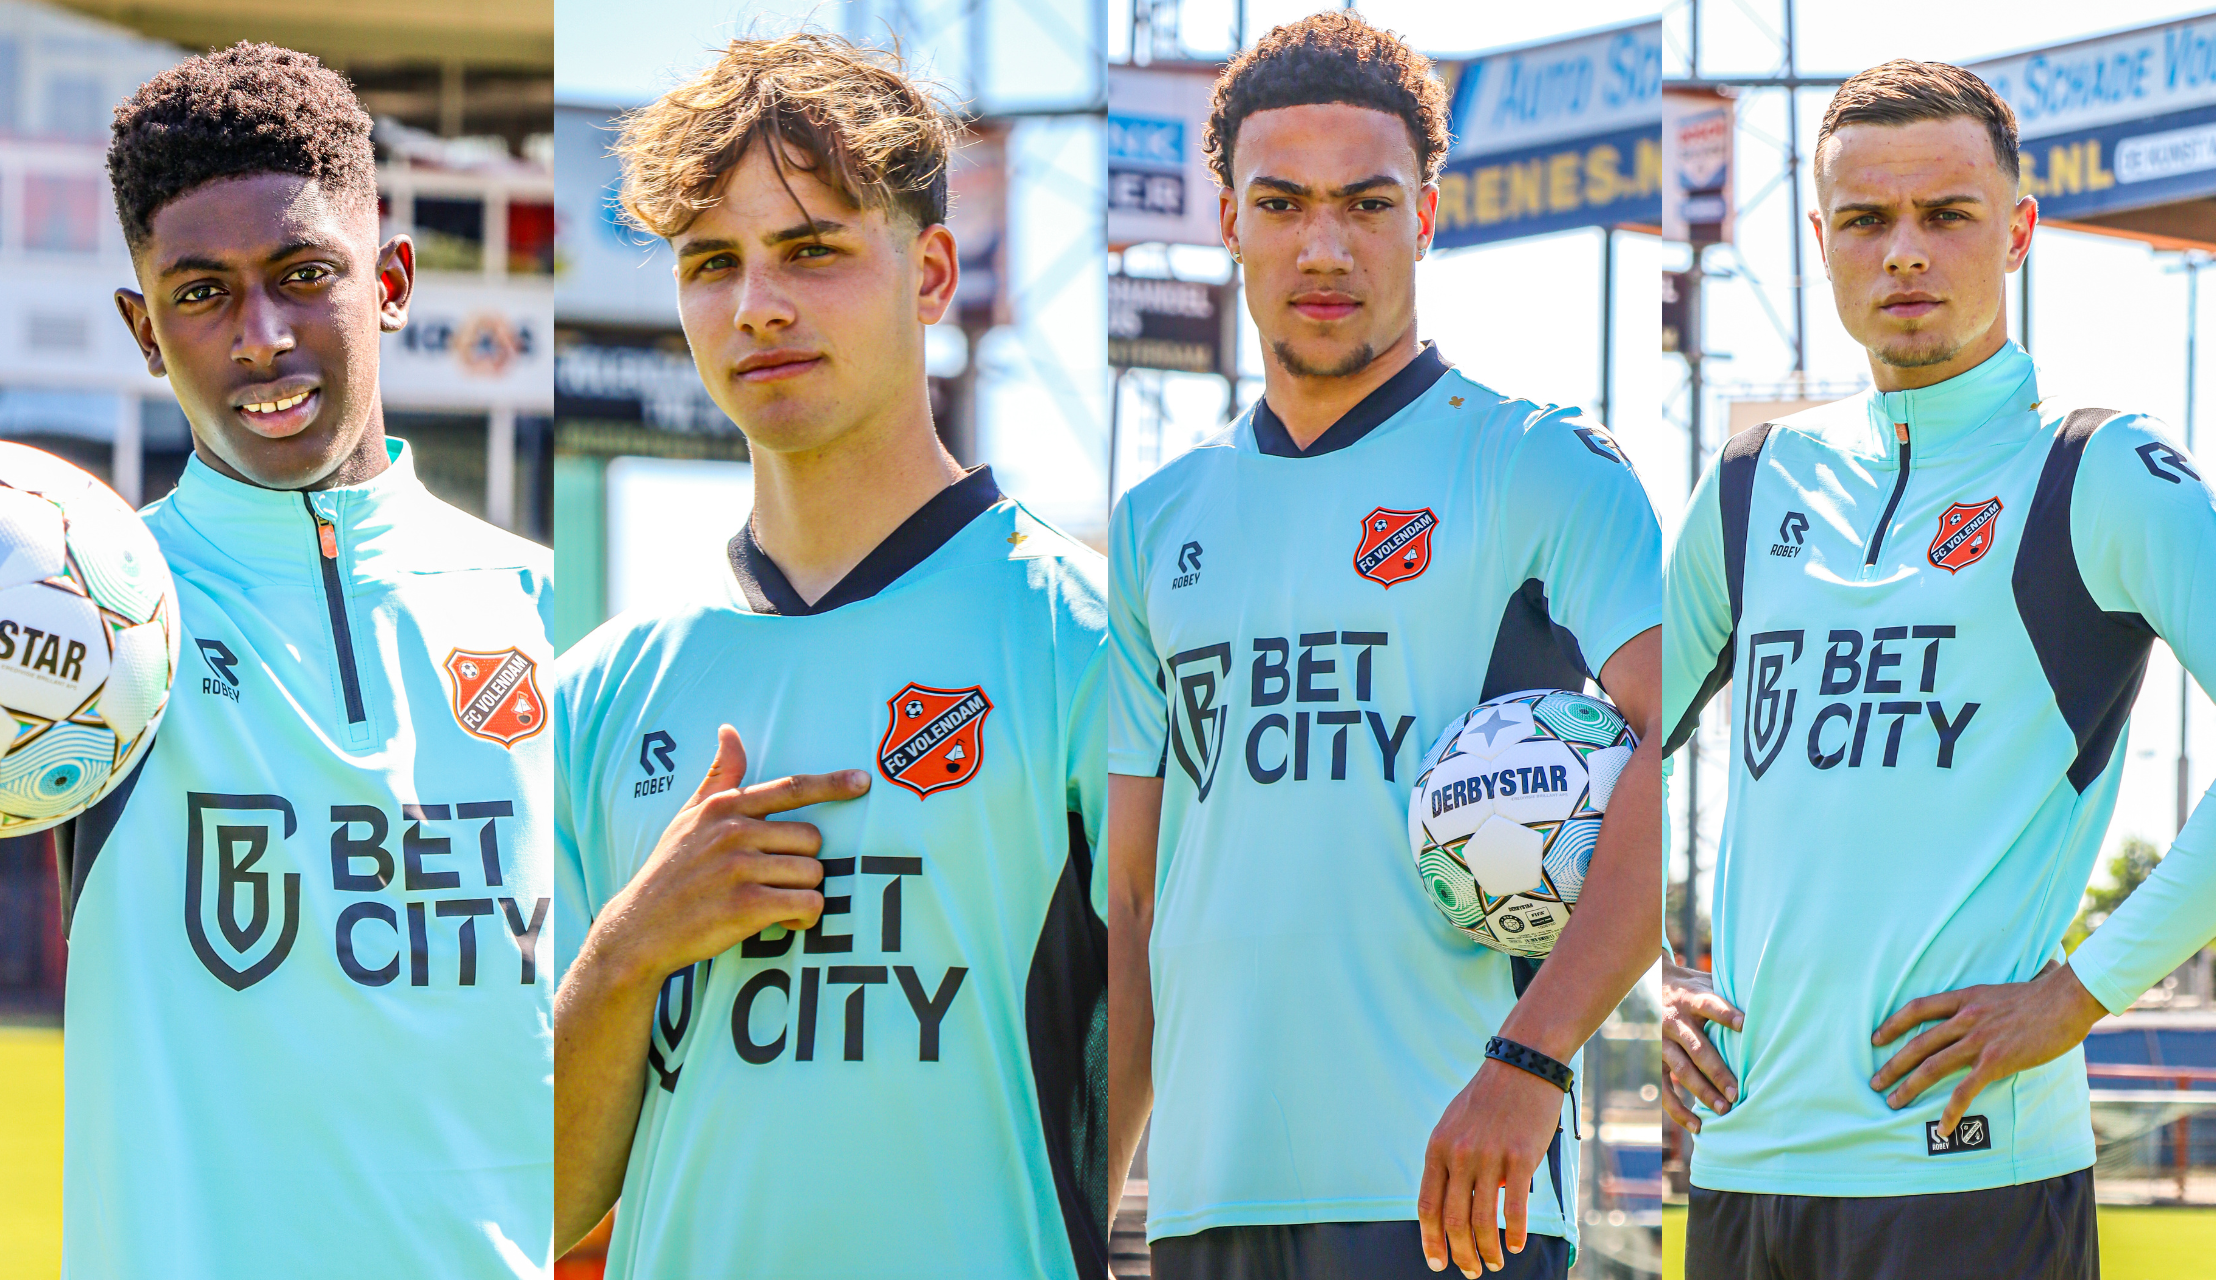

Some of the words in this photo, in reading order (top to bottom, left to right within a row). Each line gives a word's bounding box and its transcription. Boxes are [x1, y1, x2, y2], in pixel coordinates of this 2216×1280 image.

[2164, 25, 2216, 93] VO
[1359, 557, 1375, 572] FC
[1374, 514, 1433, 559] VOLENDAM
[1770, 544, 1801, 558] ROBEY
[1932, 548, 1947, 562] FC
[1946, 503, 1999, 549] VOLENDAM
[1172, 572, 1201, 590] ROBEY
[0, 619, 87, 683] STAR
[1251, 631, 1388, 707] BET
[1819, 625, 1956, 695] BET
[203, 678, 239, 703] ROBEY
[463, 709, 482, 729] FC
[475, 654, 528, 713] VOLENDAM
[884, 753, 907, 774] FC
[904, 695, 985, 757] VOLENDAM
[1245, 710, 1416, 784] CITY
[1807, 701, 1981, 770] CITY
[634, 774, 674, 798] ROBEY
[1431, 765, 1568, 819] DERBYSTAR
[331, 800, 514, 891] BET
[335, 898, 551, 987] CITY
[731, 965, 969, 1065] CITY
